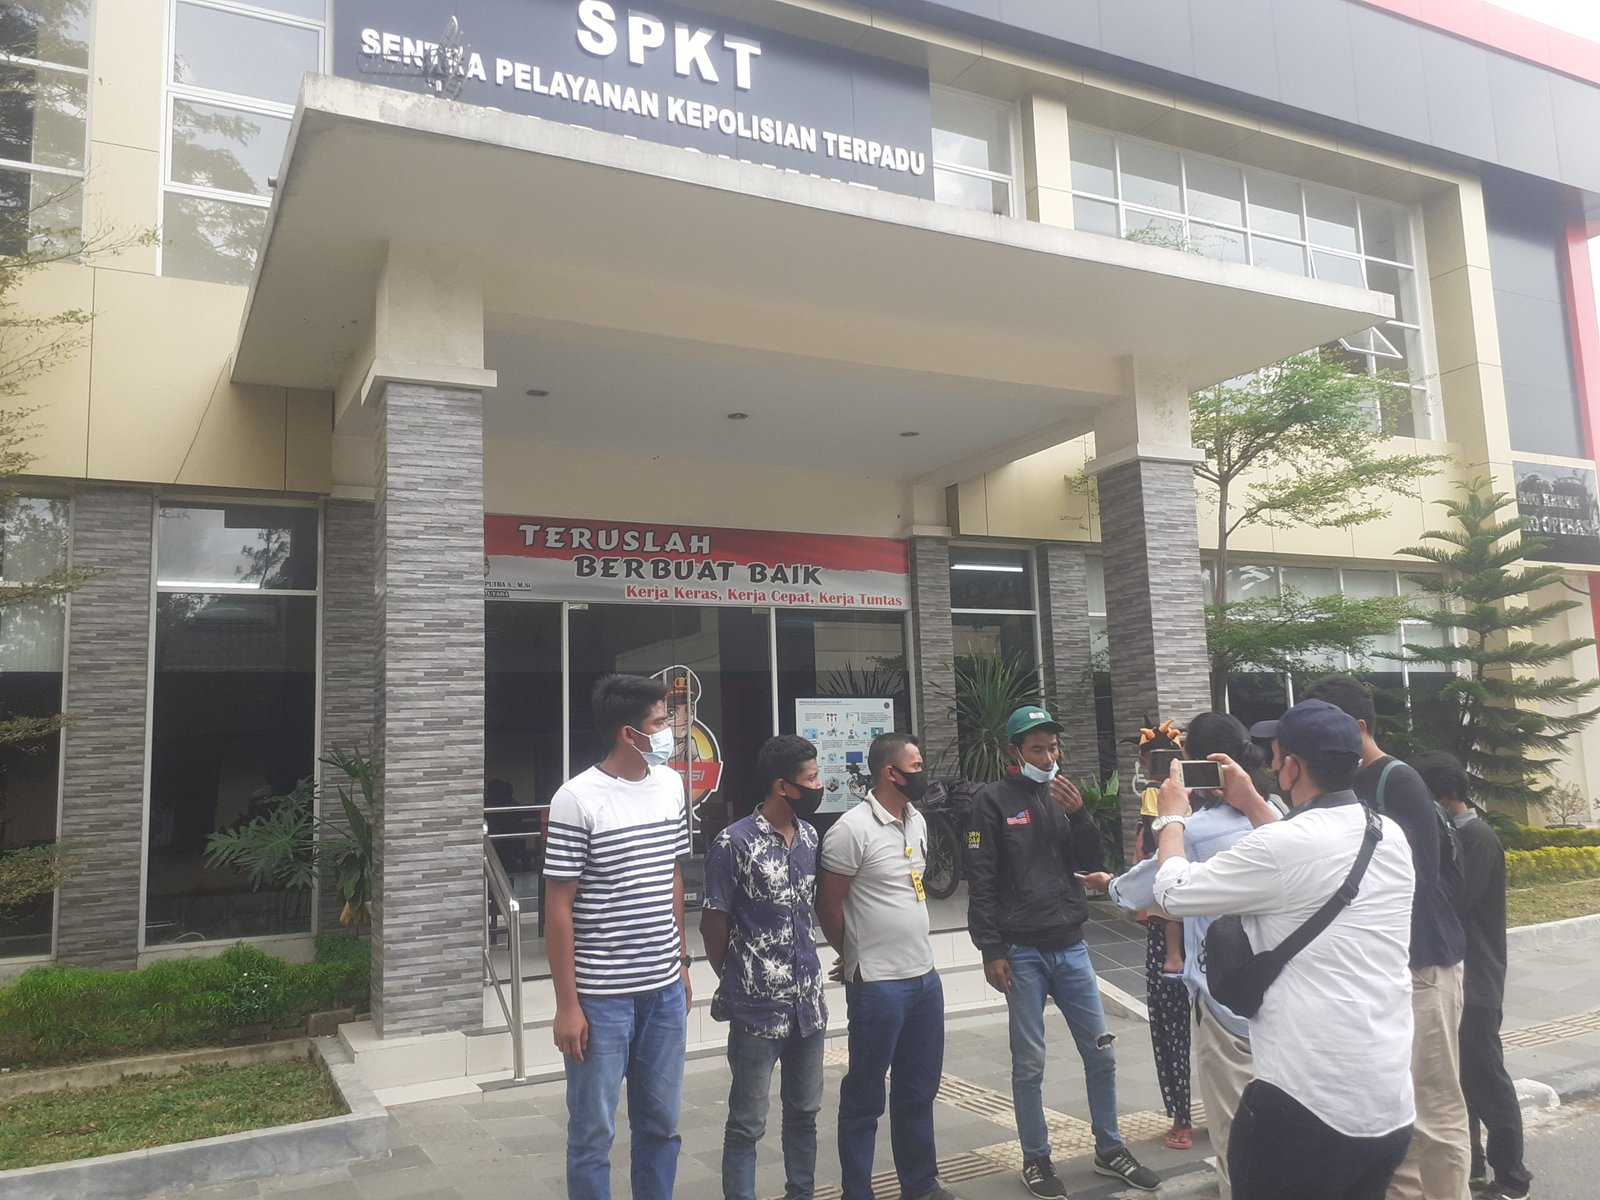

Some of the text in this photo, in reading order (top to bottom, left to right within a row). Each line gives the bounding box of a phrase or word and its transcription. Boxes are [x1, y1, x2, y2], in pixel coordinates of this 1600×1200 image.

[577, 0, 762, 91] SPKT
[496, 57, 660, 119] PELAYANAN
[667, 97, 817, 153] KEPOLISIAN
[823, 131, 926, 176] TERPADU
[518, 524, 711, 555] TERUSLAH
[573, 555, 822, 586] BERBUAT BAIK
[626, 584, 903, 607] Kerja Keras, Kerja Cepat, Kerja Tuntas
